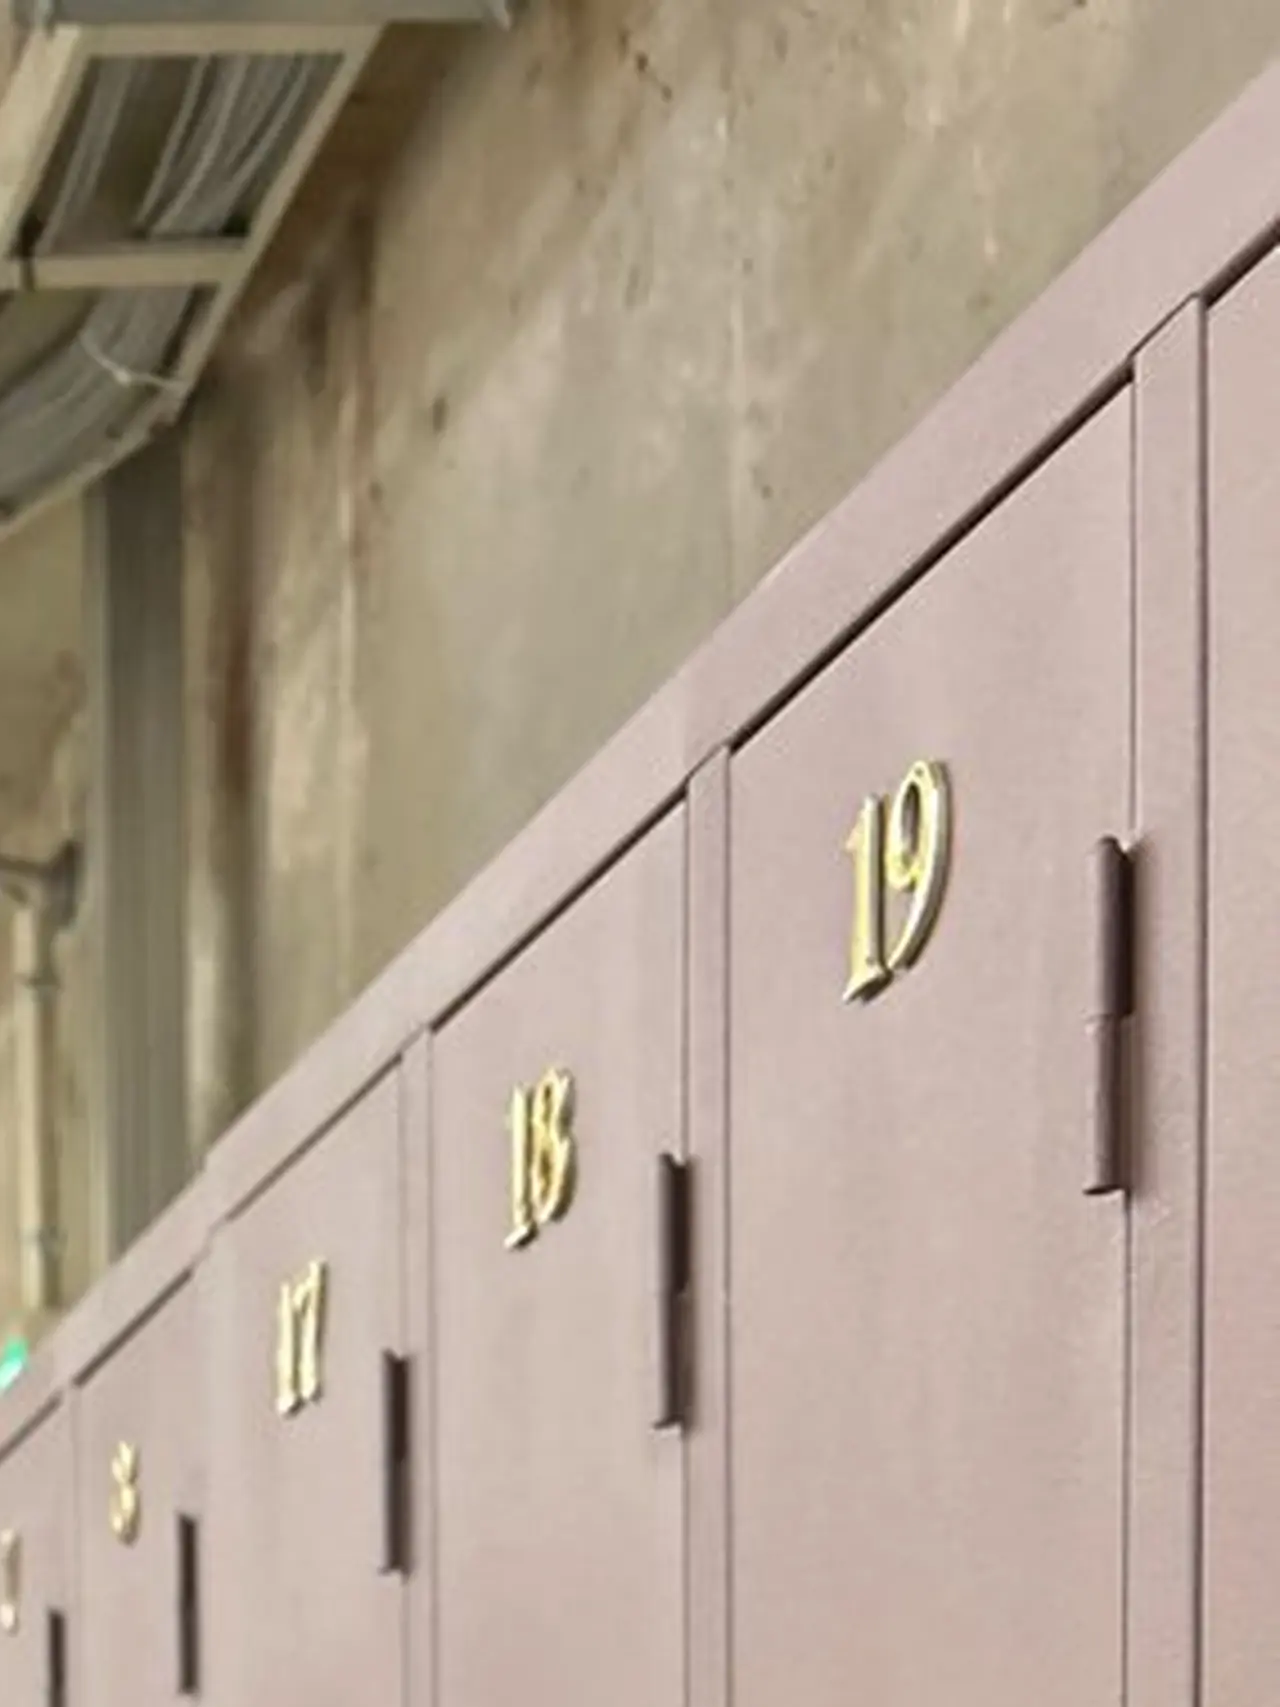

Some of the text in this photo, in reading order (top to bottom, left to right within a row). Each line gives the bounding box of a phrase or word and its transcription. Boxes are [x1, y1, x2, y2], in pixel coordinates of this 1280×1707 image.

[841, 759, 953, 1003] 19
[502, 1066, 578, 1250] 18
[275, 1257, 329, 1420] 17
